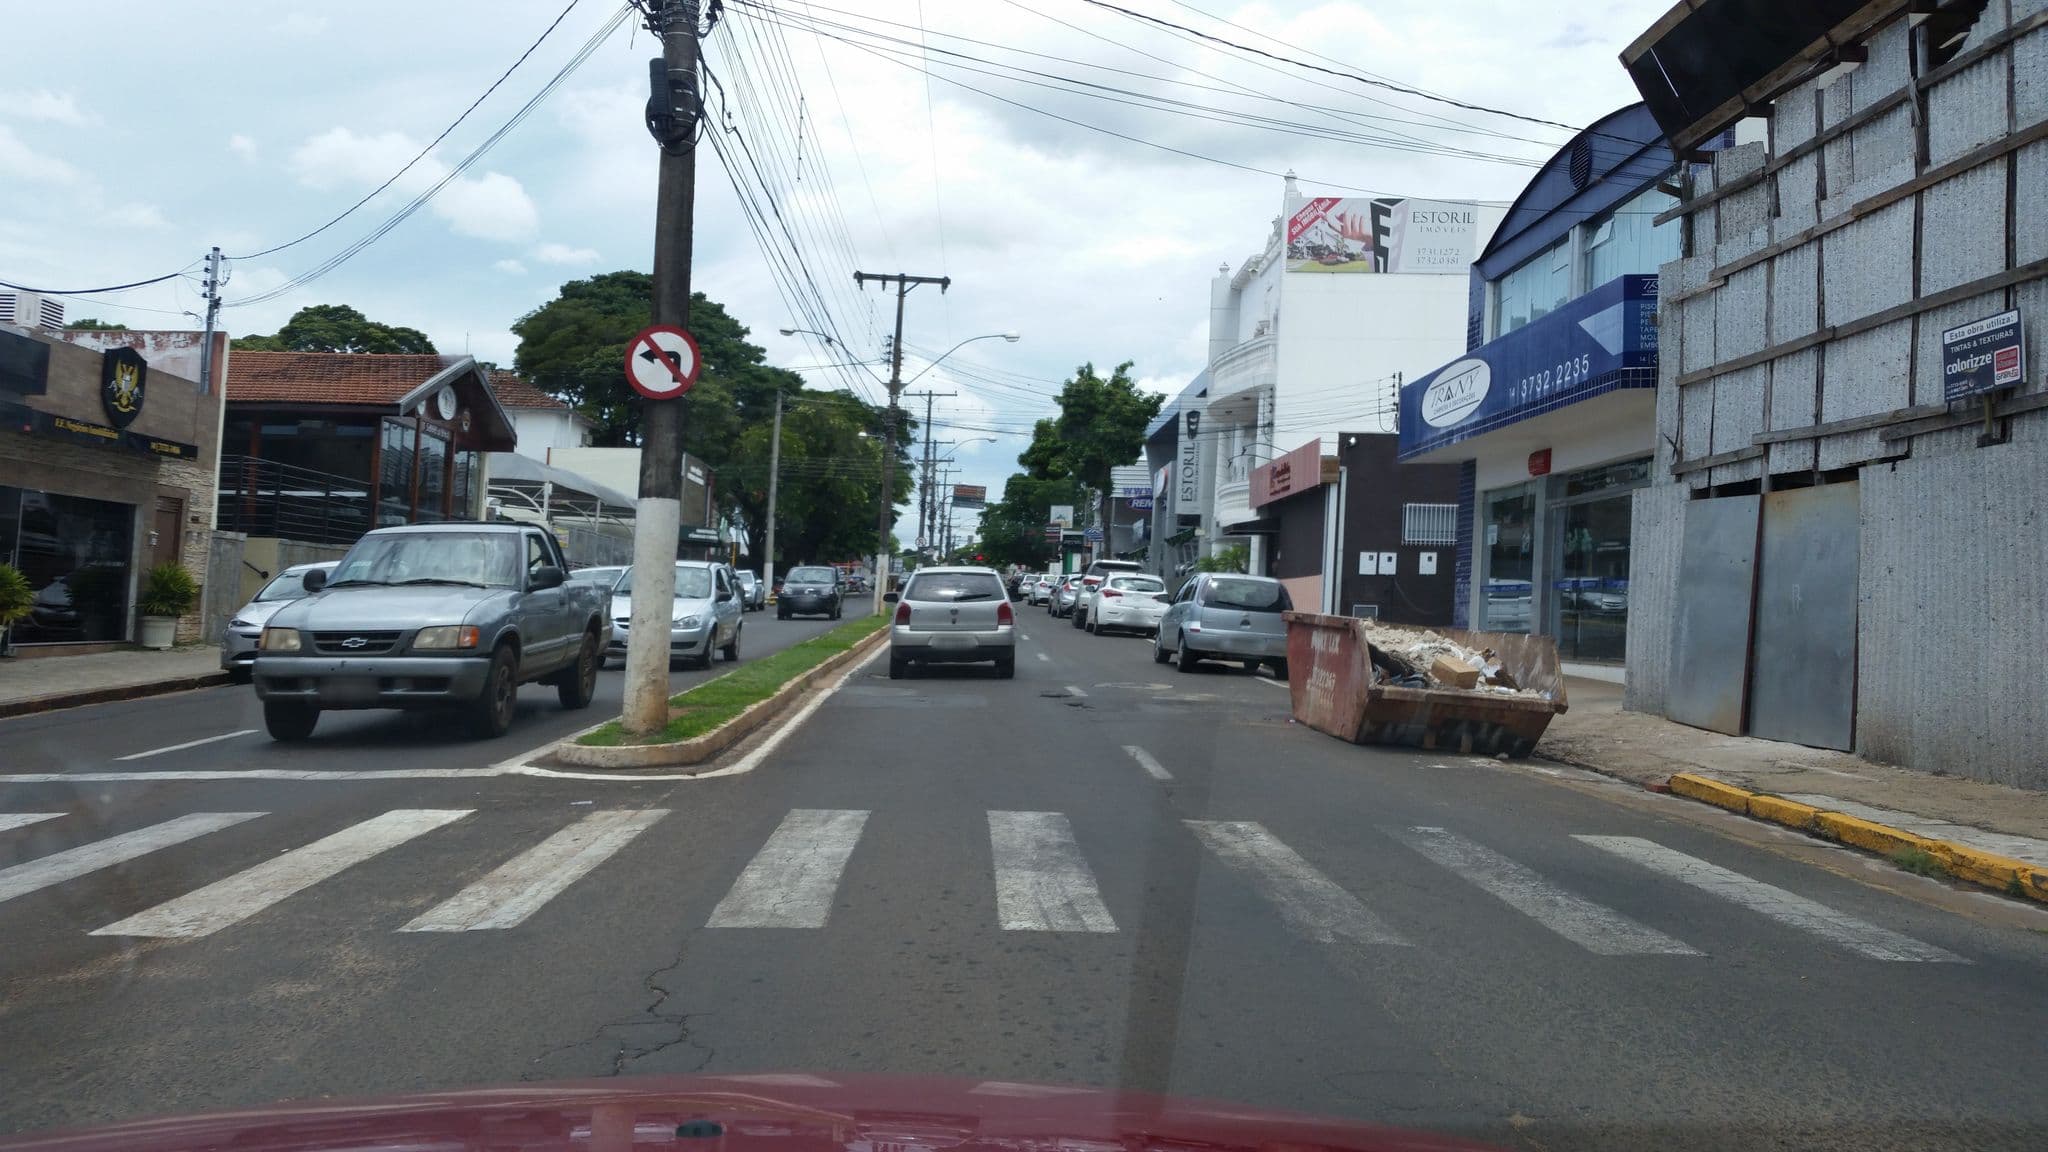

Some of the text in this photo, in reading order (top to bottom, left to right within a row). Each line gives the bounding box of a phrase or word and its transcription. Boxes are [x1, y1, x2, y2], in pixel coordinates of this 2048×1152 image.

[1411, 211, 1475, 225] ESTORIL
[1949, 329, 1966, 340] Esta
[1967, 323, 1984, 334] obra
[1950, 340, 1972, 354] TINTAS
[1978, 329, 2014, 345] TEXTURAS
[1520, 353, 1590, 397] 3732.2235
[1946, 353, 1992, 375] colorizze
[1181, 442, 1196, 502] ESTORIL
